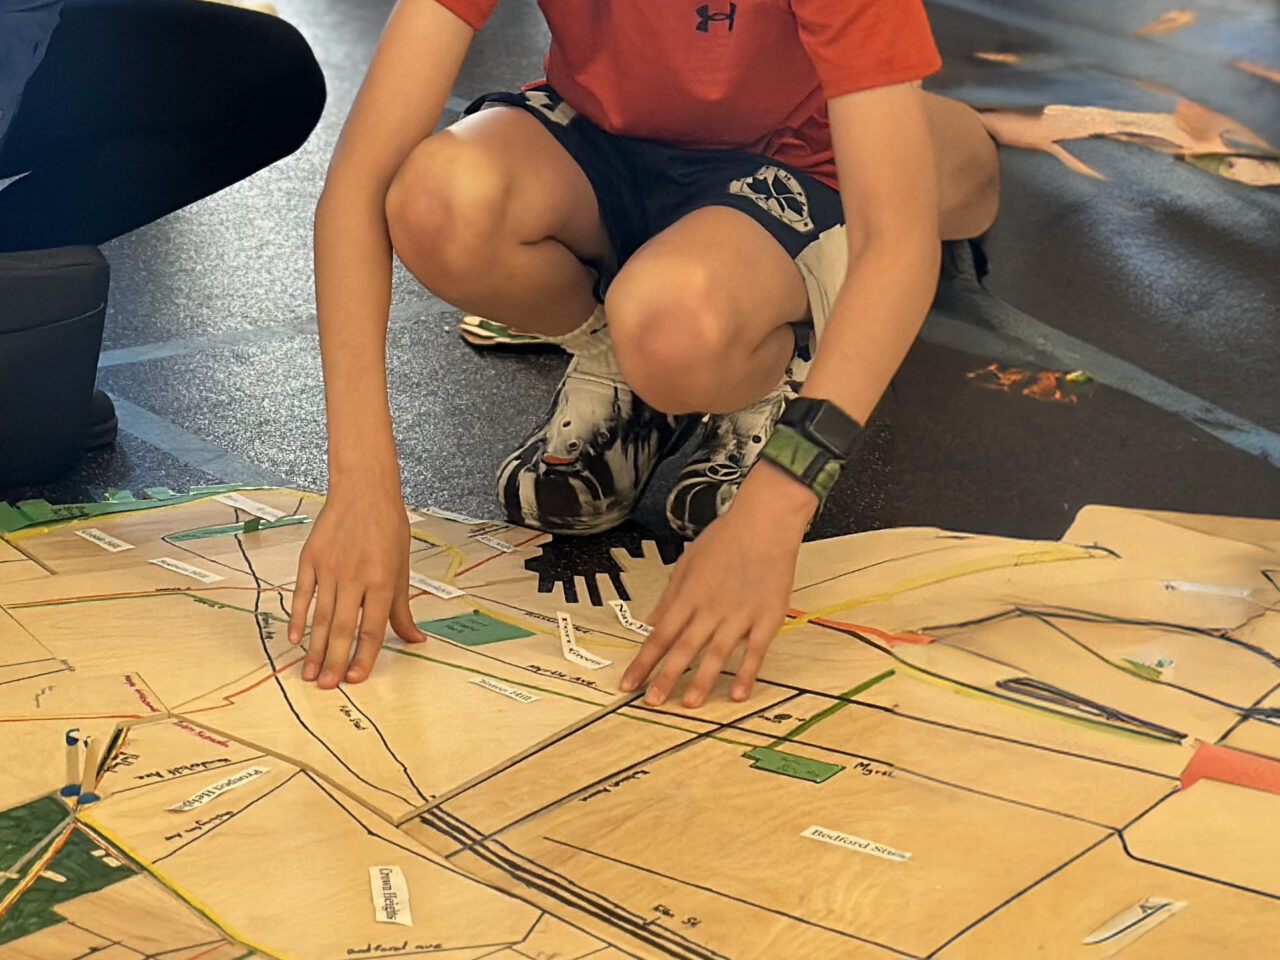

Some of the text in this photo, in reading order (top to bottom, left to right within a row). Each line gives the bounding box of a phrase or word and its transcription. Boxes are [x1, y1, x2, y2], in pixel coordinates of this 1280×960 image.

[636, 623, 651, 634] Ya
[811, 828, 870, 851] Bedford
[378, 867, 398, 921] Crown Heights
